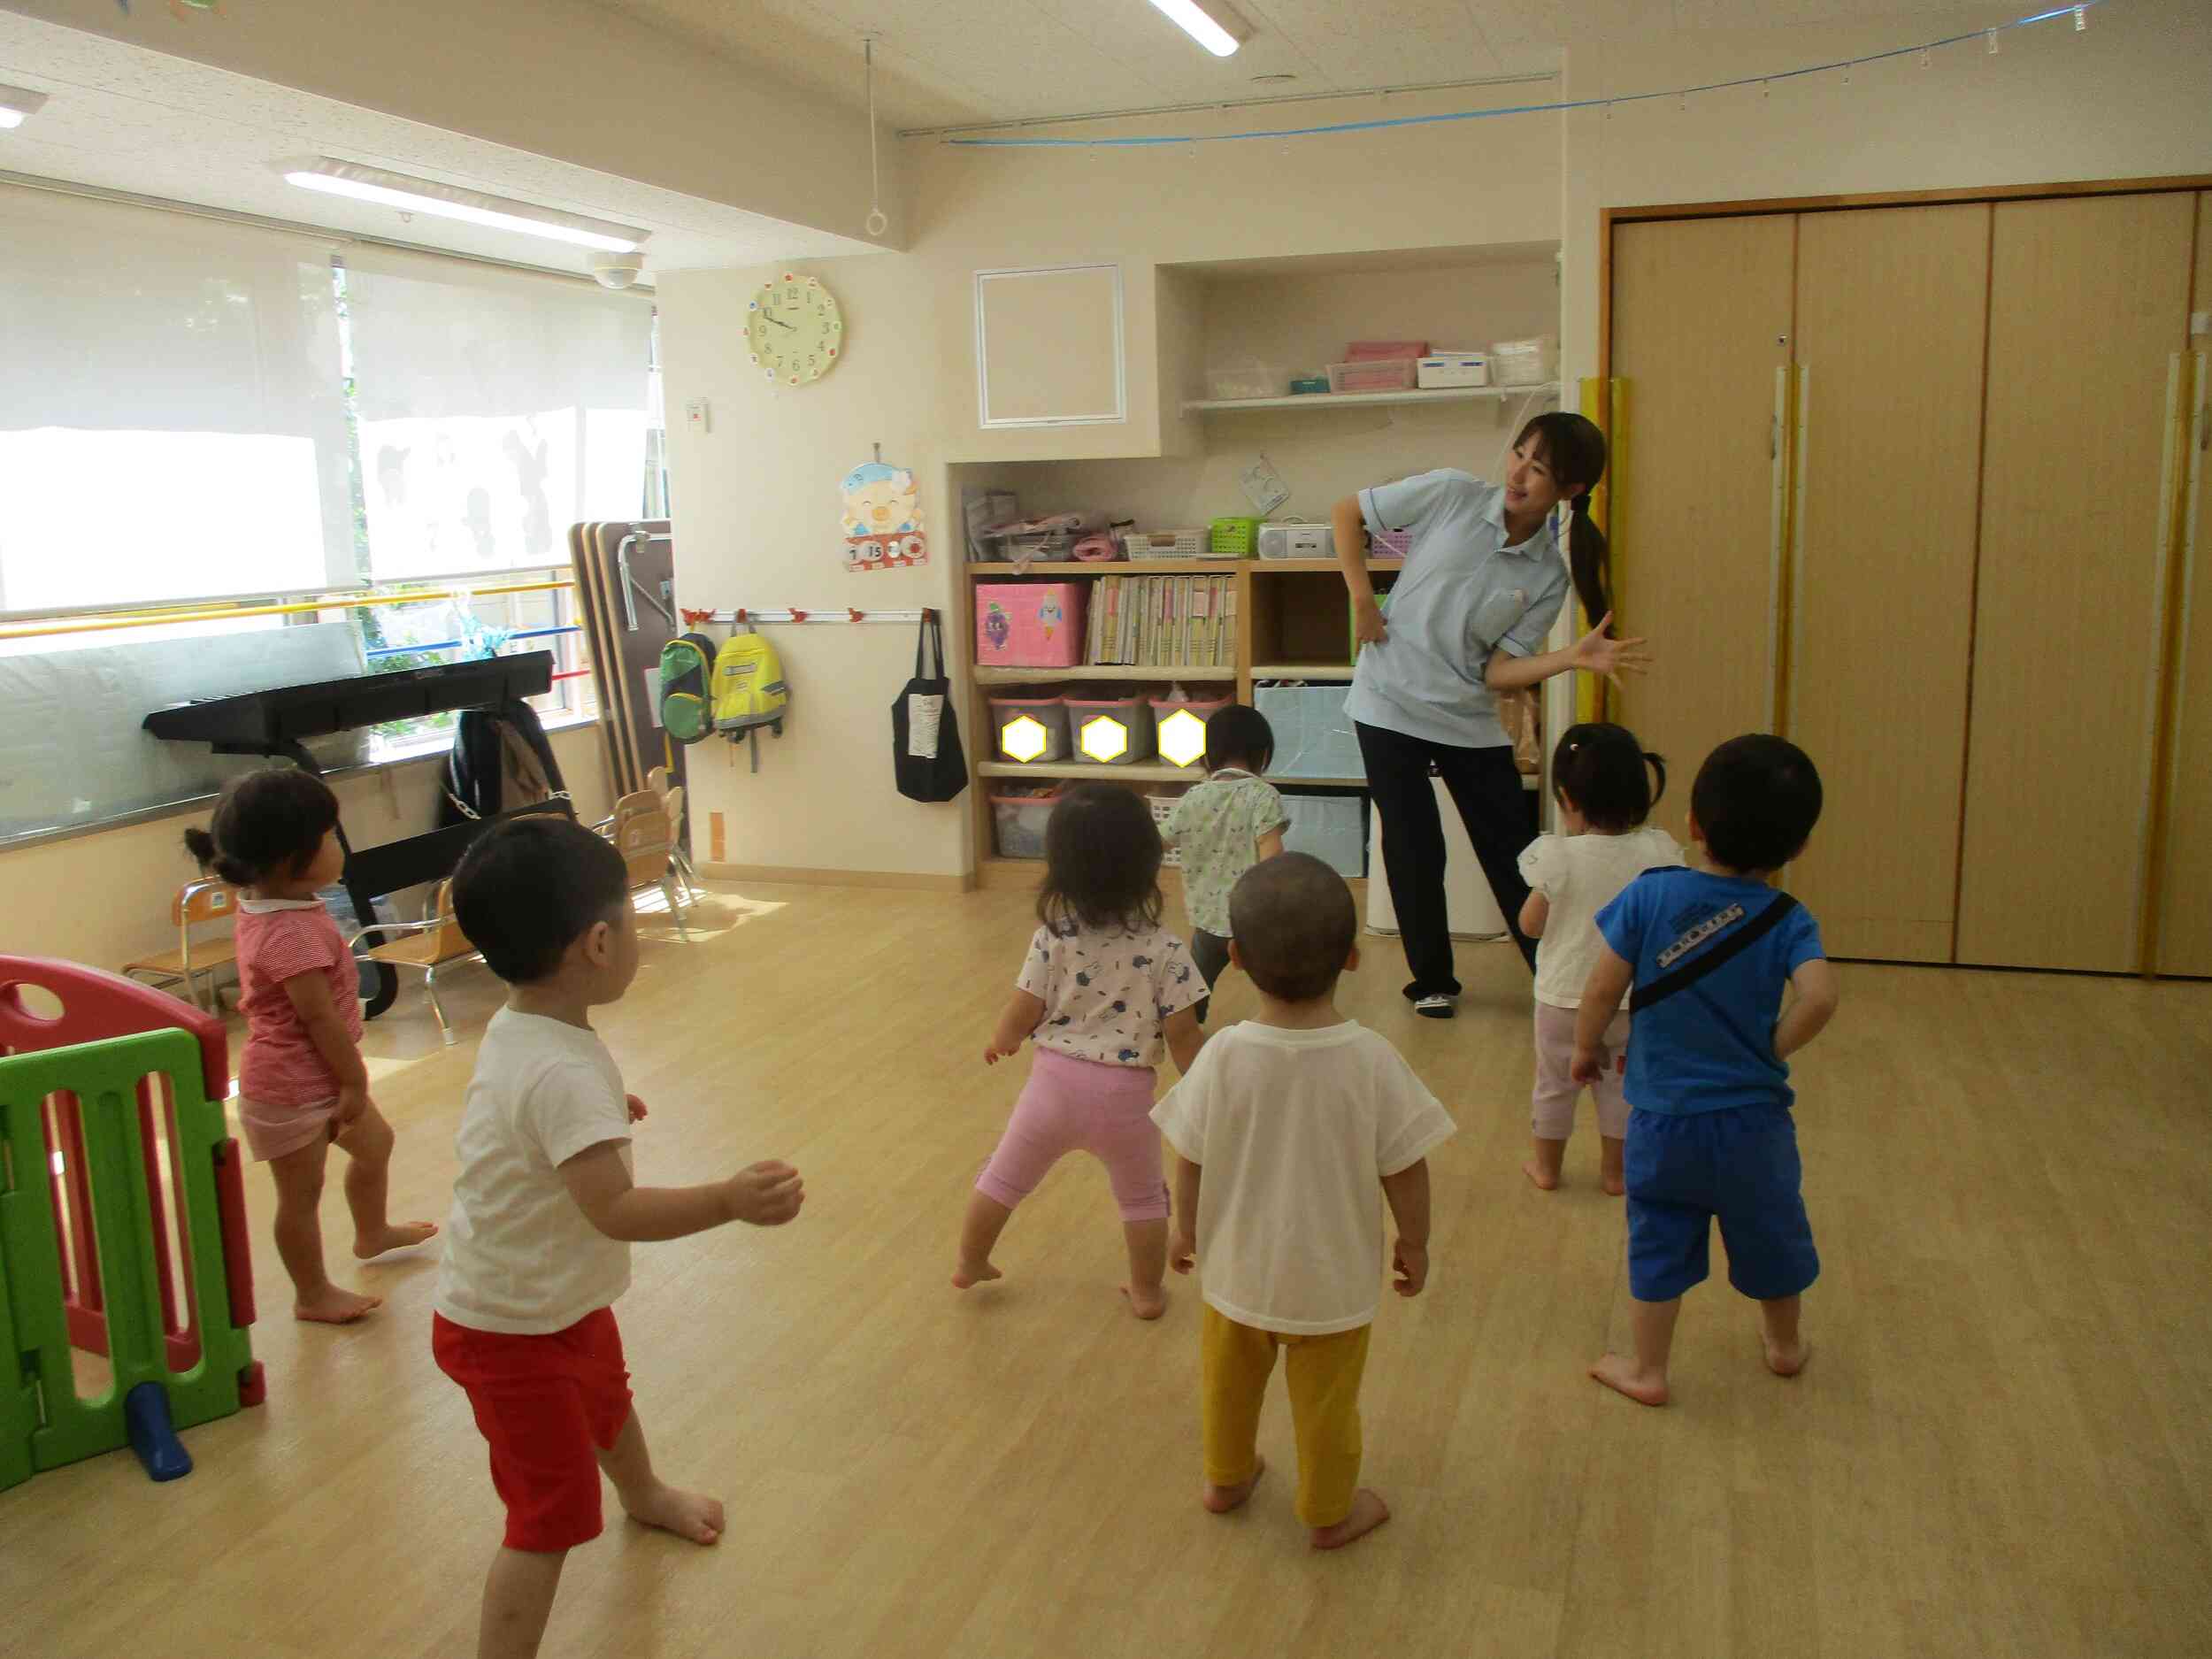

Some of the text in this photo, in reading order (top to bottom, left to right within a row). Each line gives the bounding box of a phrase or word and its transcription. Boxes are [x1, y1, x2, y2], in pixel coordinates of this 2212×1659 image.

[787, 287, 799, 300] 12
[817, 303, 826, 317] 2
[758, 325, 767, 337] 9
[821, 321, 830, 334] 3
[764, 342, 772, 354] 8
[818, 340, 826, 352] 4
[776, 355, 785, 368] 7
[792, 358, 801, 372] 6
[808, 354, 816, 366] 5
[867, 546, 881, 557] 15
